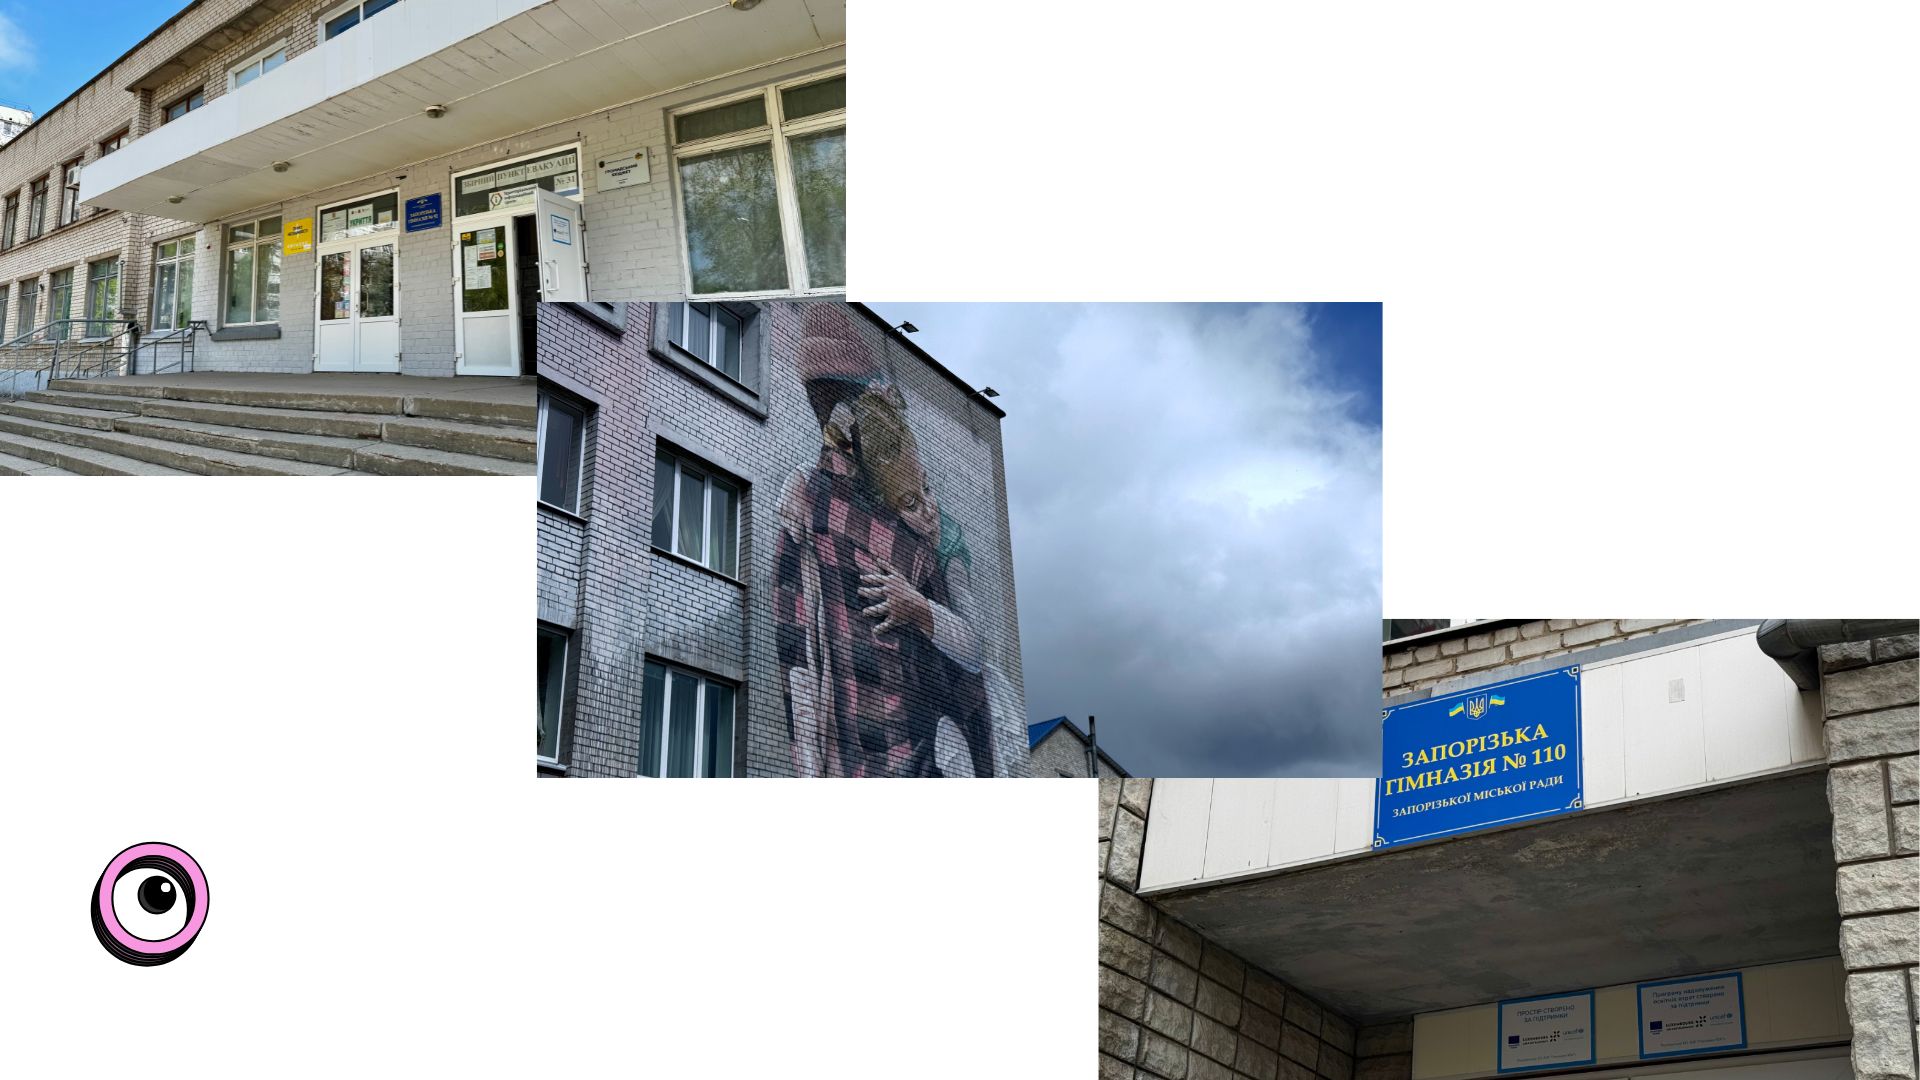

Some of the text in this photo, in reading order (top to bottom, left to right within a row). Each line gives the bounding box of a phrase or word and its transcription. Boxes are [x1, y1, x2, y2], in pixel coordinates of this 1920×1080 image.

[497, 168, 526, 182] ПУНКТ
[1402, 723, 1548, 769] ЗАПОРІЗЬКА
[1385, 743, 1567, 796] ГІМНАЗІЯ № 110
[1392, 774, 1564, 818] ЗАПОРІЗЬКОЇ МІСЬКОЇ РАДИ
